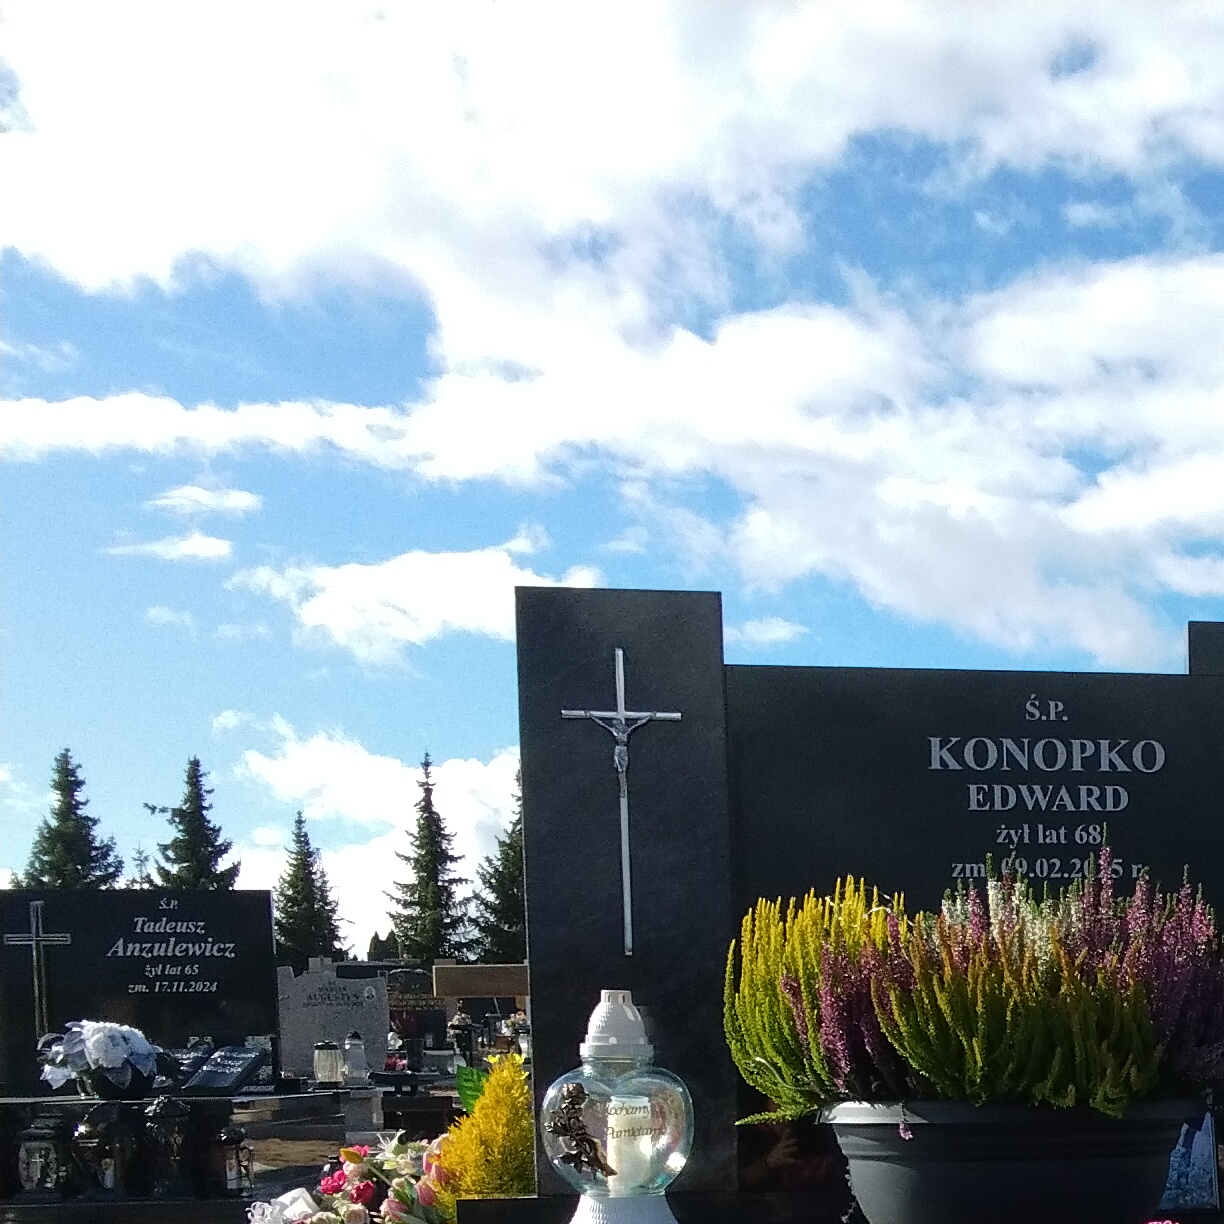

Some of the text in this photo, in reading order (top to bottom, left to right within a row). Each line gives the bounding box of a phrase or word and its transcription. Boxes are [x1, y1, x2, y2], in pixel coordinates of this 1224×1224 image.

[1025, 694, 1068, 721] Ś.P.
[927, 736, 1166, 773] KONOPKO
[966, 784, 1129, 812] EDWARD
[996, 823, 1101, 849] żył lat 68
[1002, 857, 1123, 879] 09.02.205
[133, 916, 206, 934] Tadeusz
[106, 937, 236, 958] Anzulewicz
[144, 963, 199, 977] żył lat 65
[127, 981, 218, 993] zm. 17.11.2024
